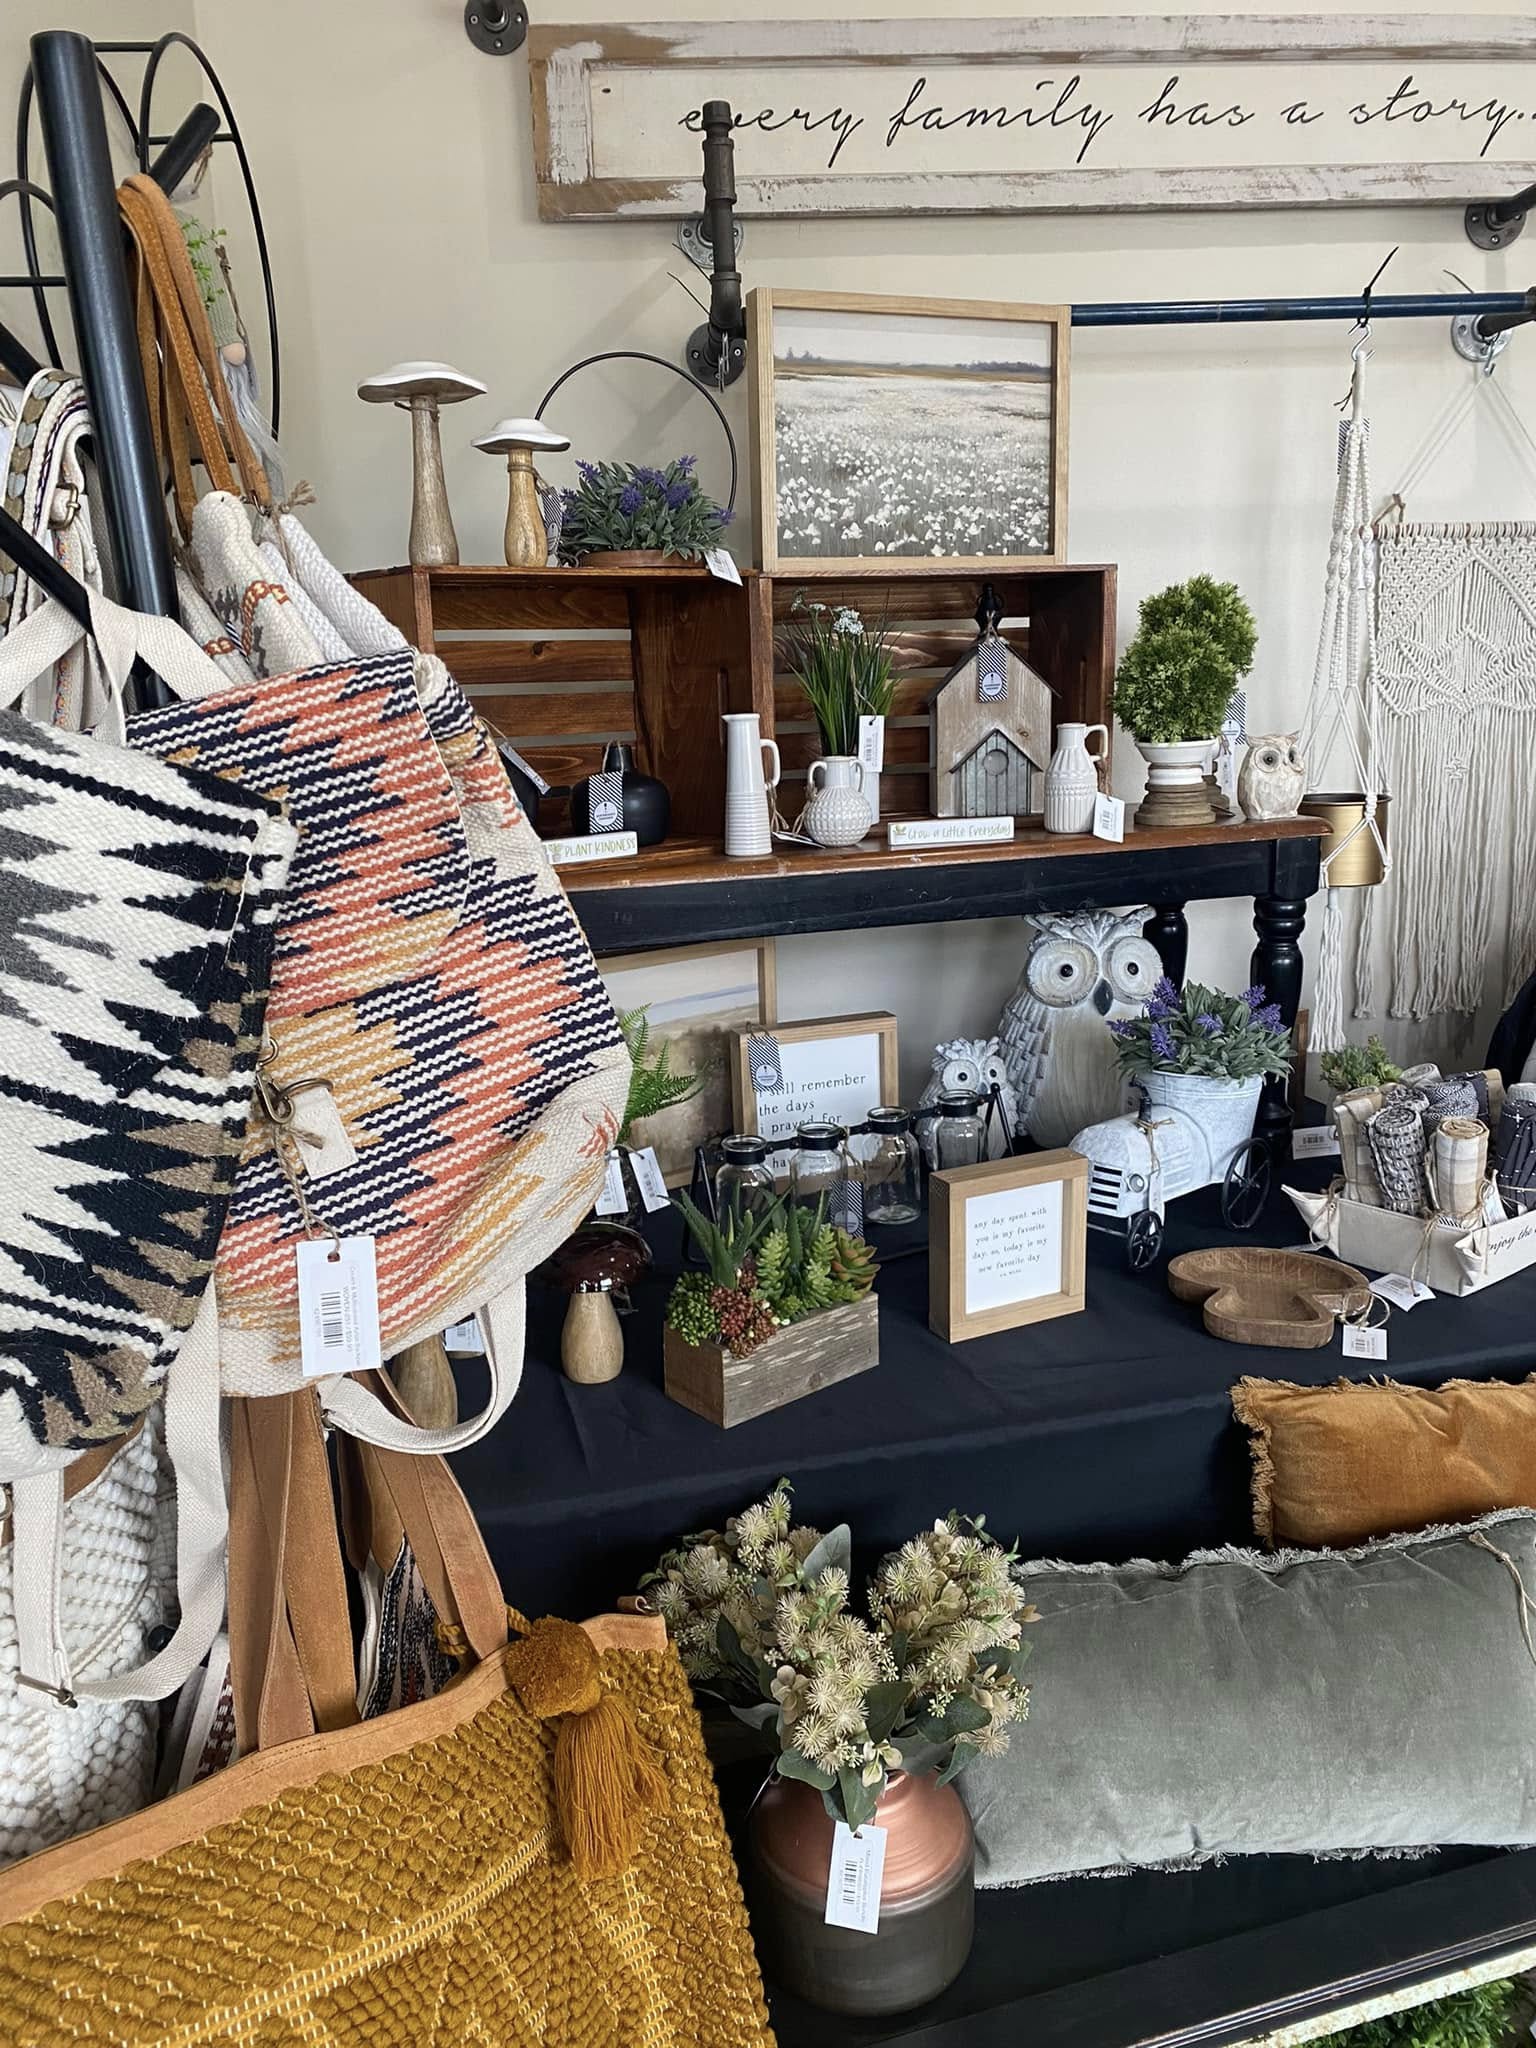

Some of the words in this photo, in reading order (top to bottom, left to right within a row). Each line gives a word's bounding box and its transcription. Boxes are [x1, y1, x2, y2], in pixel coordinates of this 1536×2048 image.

[886, 75, 1114, 164] family
[1138, 75, 1256, 126] has
[1280, 101, 1324, 125] a
[565, 843, 592, 857] PLANT
[594, 838, 636, 855] KINDNESS
[801, 1073, 866, 1093] remember
[759, 1104, 779, 1117] the
[786, 1100, 815, 1113] days
[822, 1113, 842, 1124] for
[992, 1217, 1004, 1226] day
[1009, 1211, 1027, 1222] spent
[1031, 1207, 1047, 1216] with
[1488, 1236, 1516, 1255] njoy
